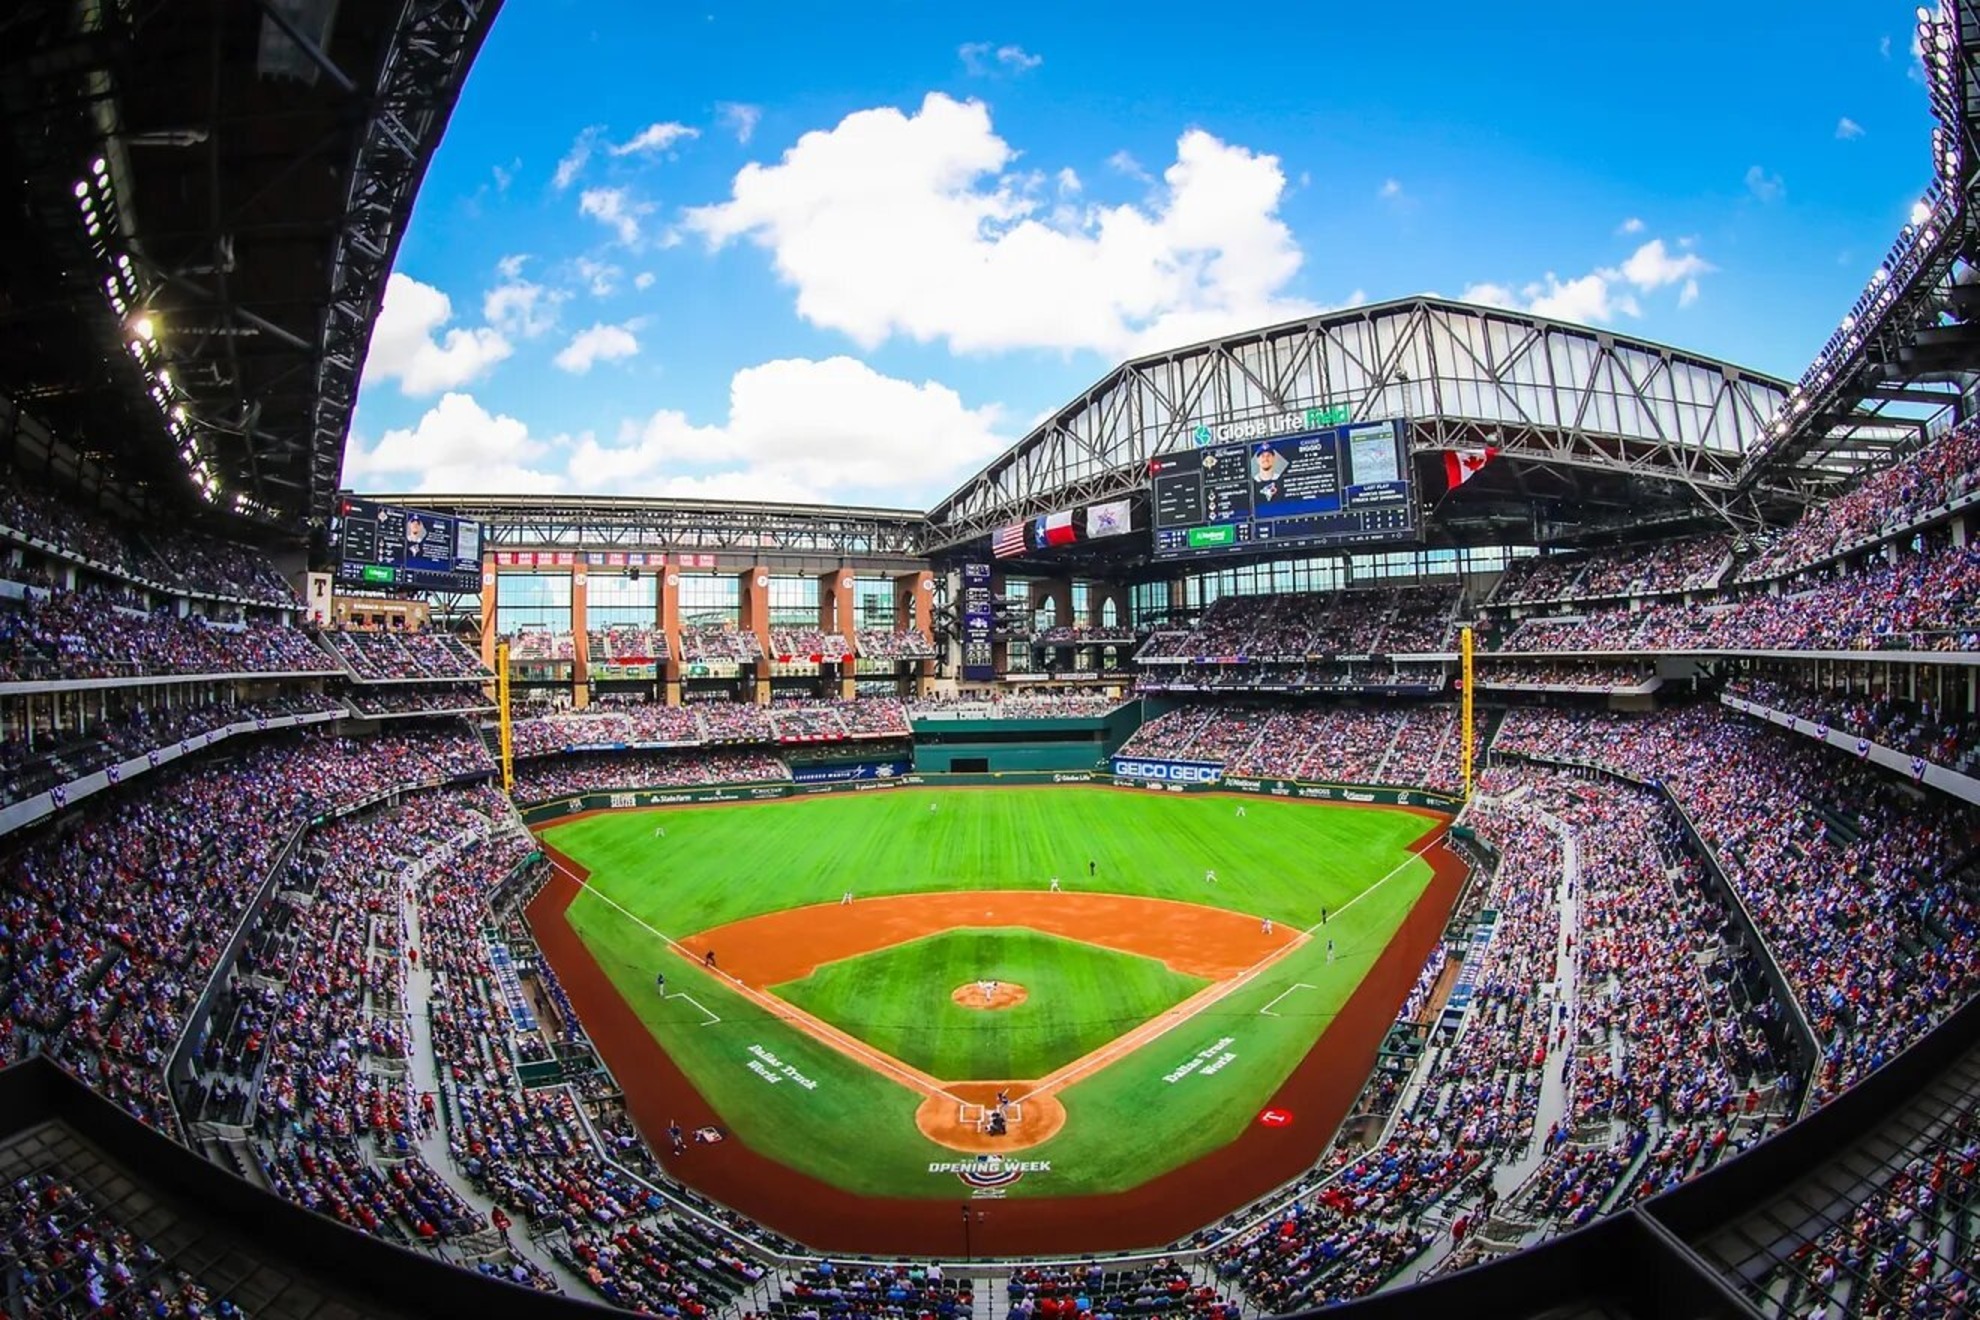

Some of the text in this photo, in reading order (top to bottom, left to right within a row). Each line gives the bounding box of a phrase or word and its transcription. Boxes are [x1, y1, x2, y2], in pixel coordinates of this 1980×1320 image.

[1216, 403, 1349, 442] Globe Life Field
[314, 578, 327, 597] T
[1115, 761, 1167, 778] GEICO
[1233, 779, 1261, 788] National
[747, 1044, 817, 1090] Dallas Truck
[1162, 1037, 1236, 1083] Dallas Truck
[1198, 1052, 1237, 1075] World
[746, 1060, 783, 1084] World
[1262, 1111, 1285, 1122] T
[928, 1160, 1051, 1173] OPENING WEEK
